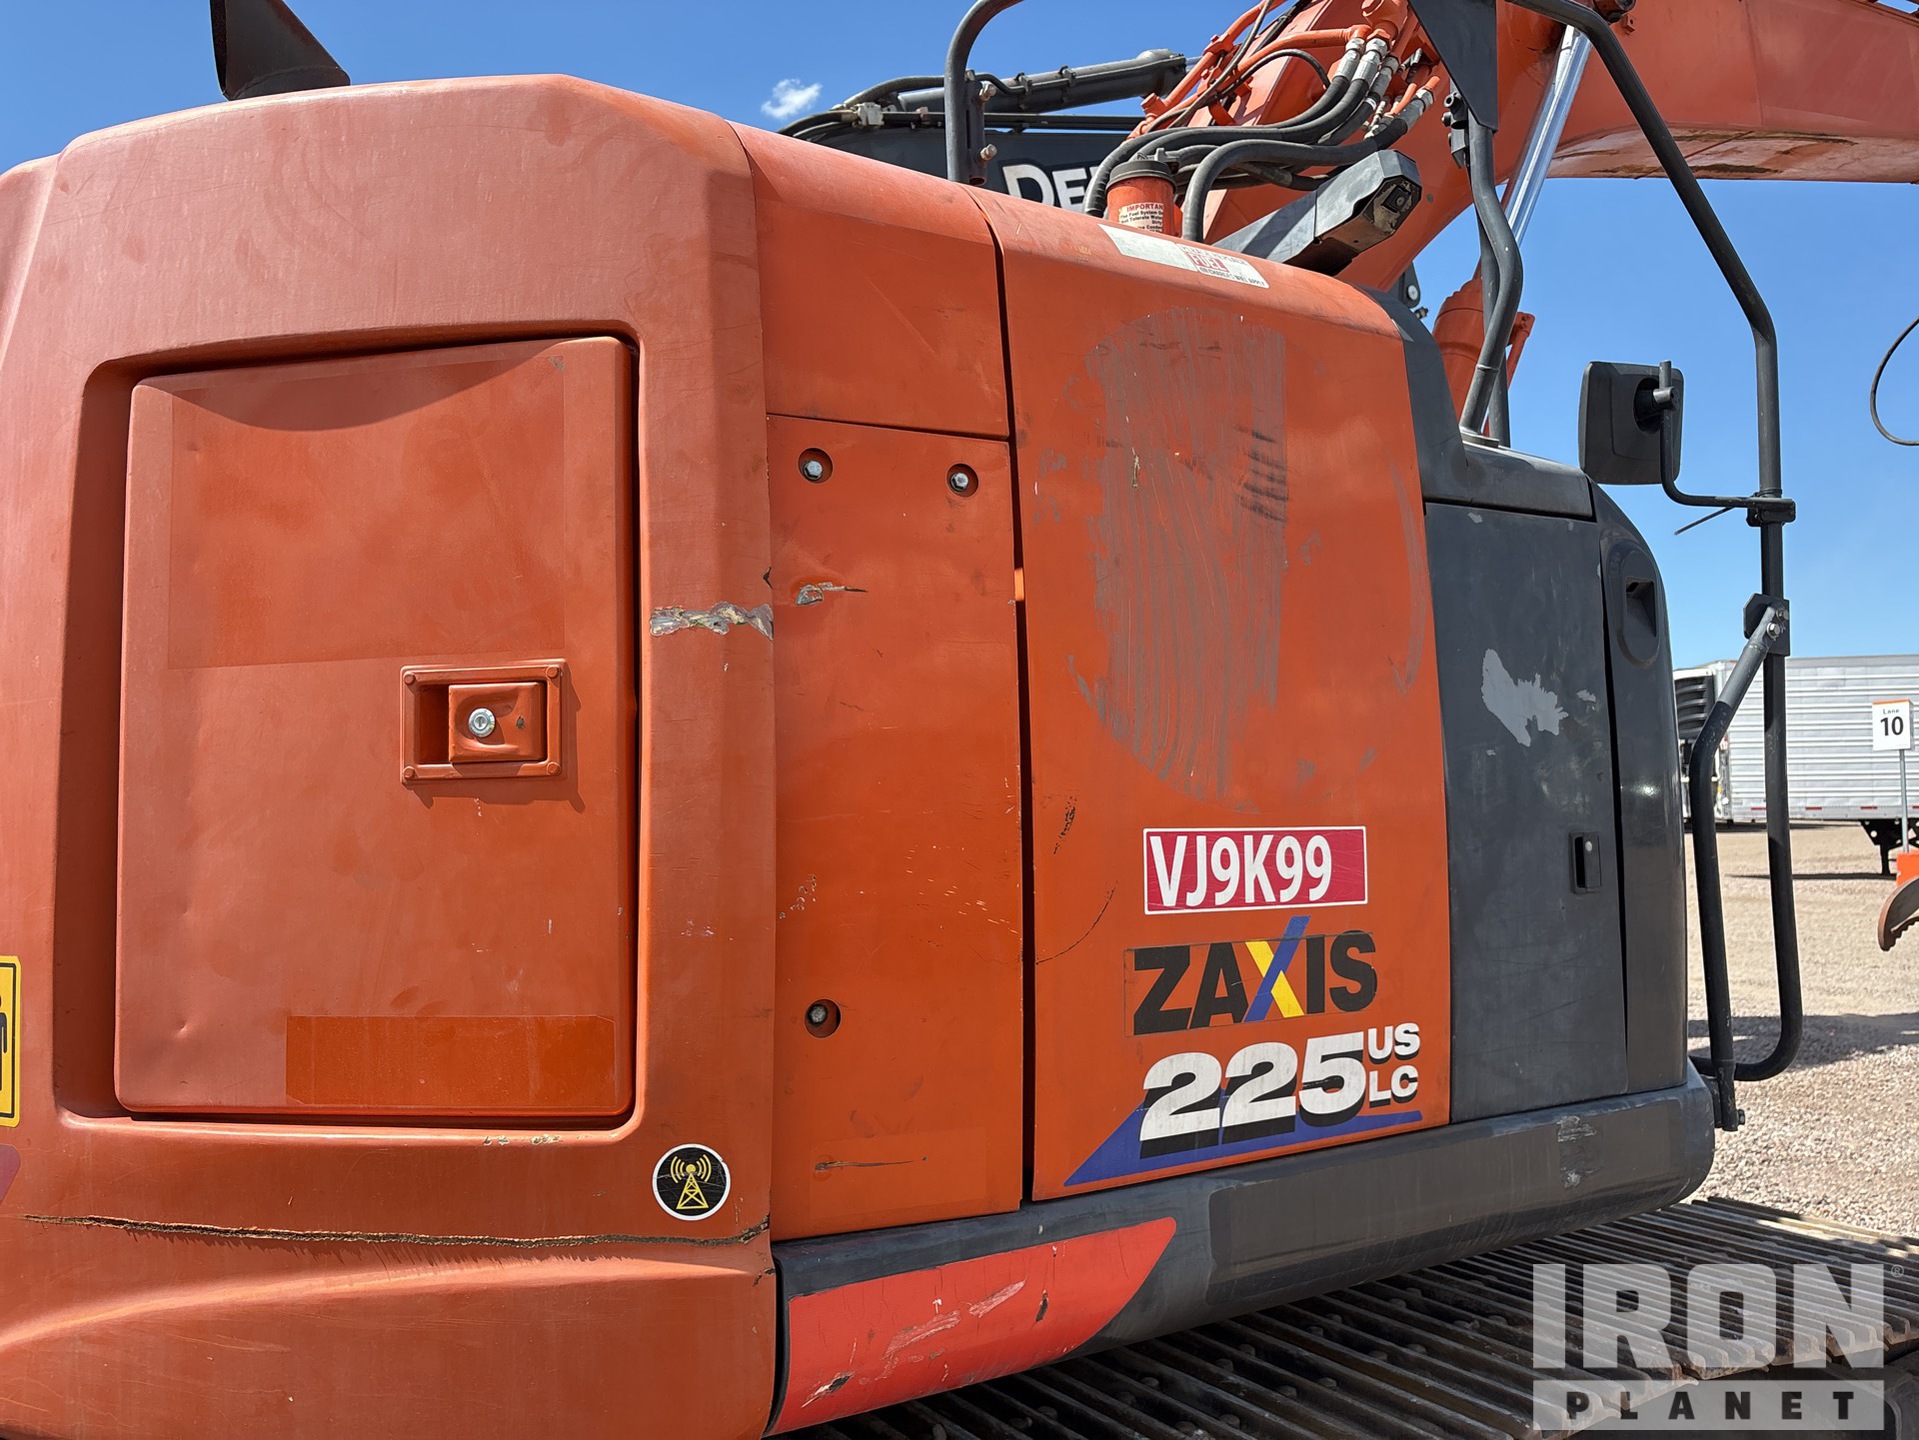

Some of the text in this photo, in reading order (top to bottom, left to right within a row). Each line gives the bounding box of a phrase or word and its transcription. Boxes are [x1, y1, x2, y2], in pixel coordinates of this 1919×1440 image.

[1002, 164, 1100, 214] DE
[1127, 204, 1164, 212] IMPORTAN
[1187, 254, 1229, 272] FUEL
[1880, 716, 1904, 737] 10
[1149, 834, 1332, 907] VJ9K99
[1133, 915, 1378, 1036] ZAXIS
[1140, 1023, 1421, 1152] 225 US
[1369, 1065, 1419, 1105] LC
